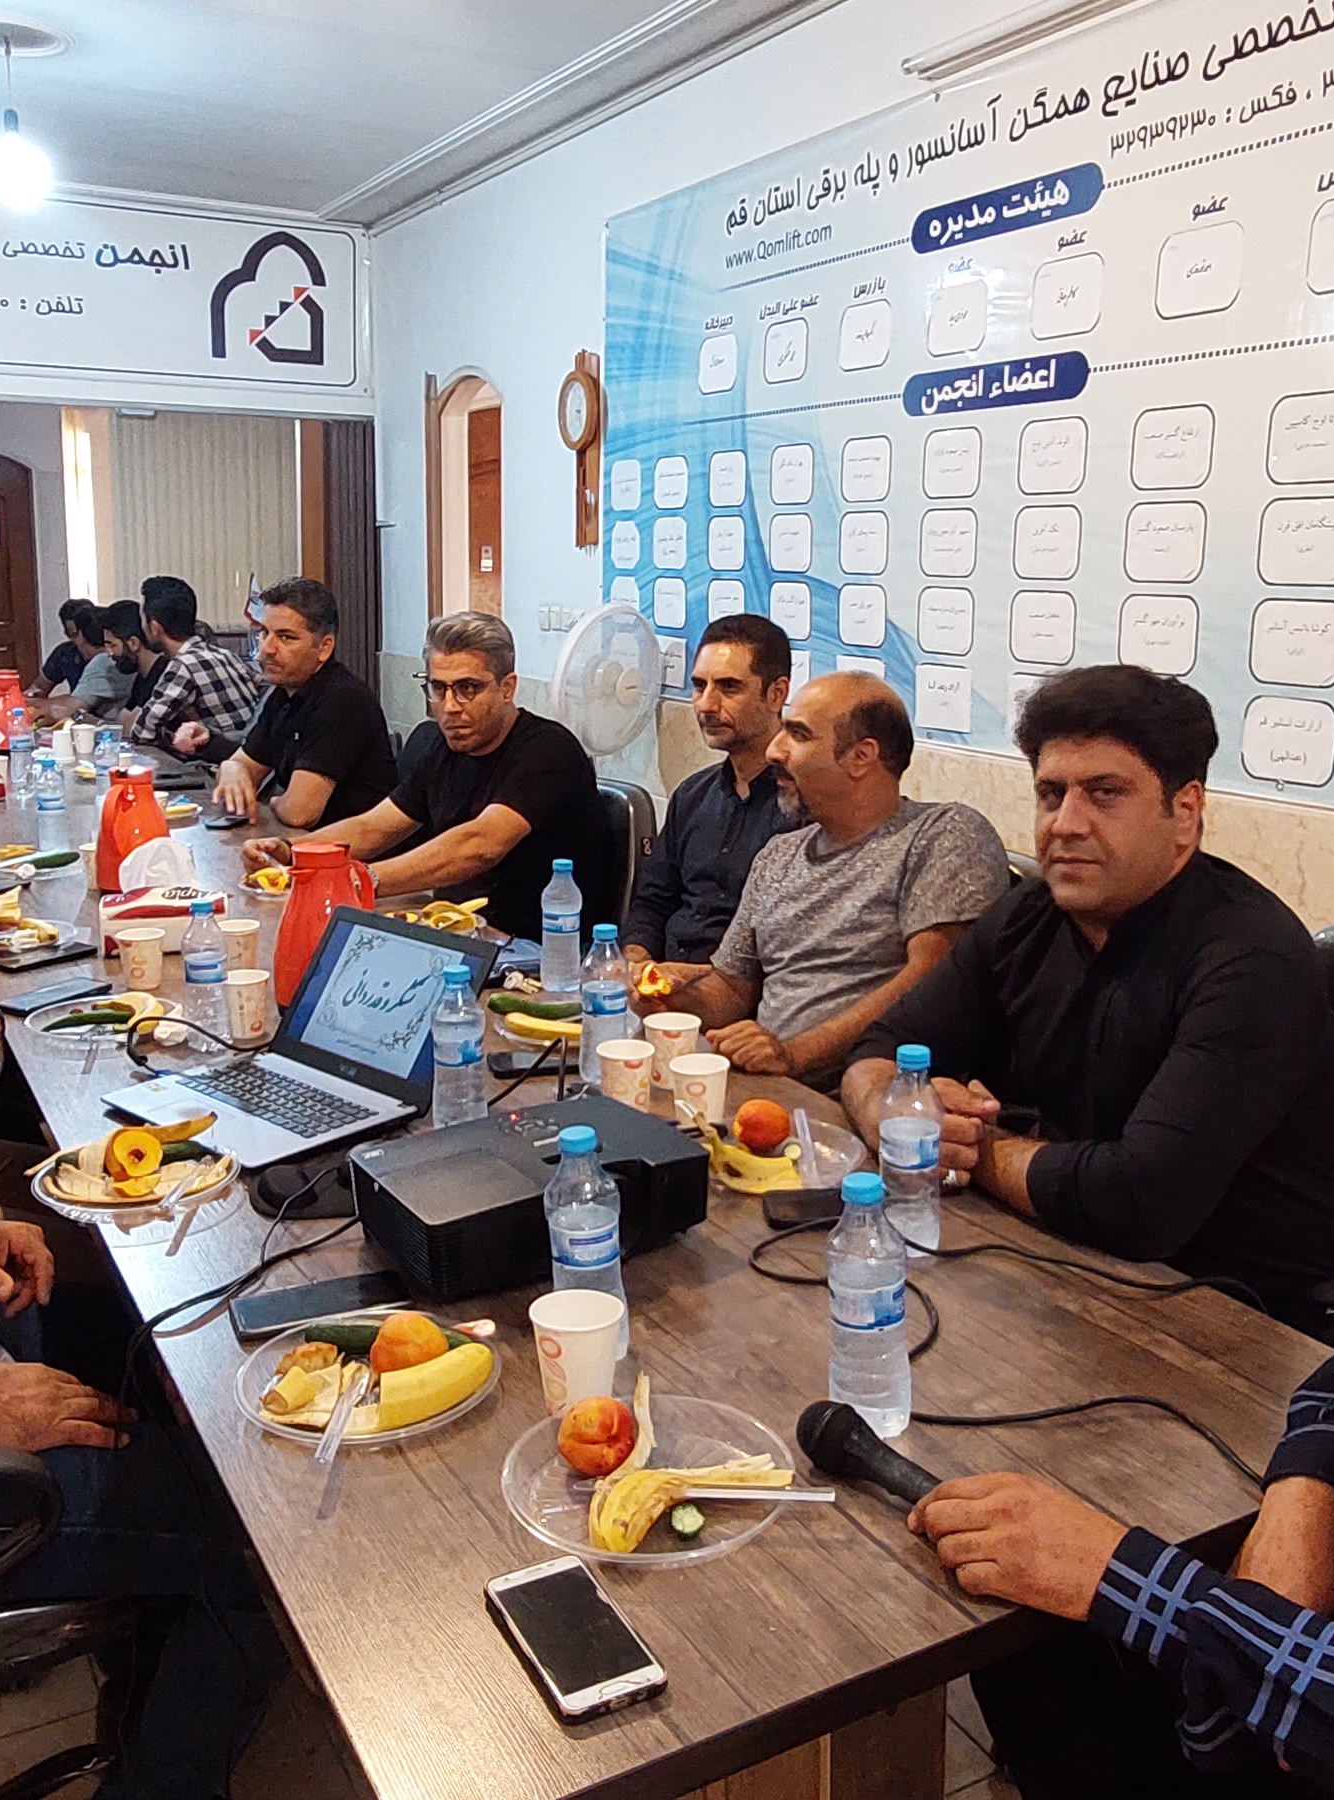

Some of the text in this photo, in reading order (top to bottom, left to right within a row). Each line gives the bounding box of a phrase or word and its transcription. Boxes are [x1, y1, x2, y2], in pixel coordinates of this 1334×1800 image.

[1100, 49, 1190, 118] صنایع
[1238, 81, 1298, 125] فکس
[1008, 87, 1091, 142] همگن
[1109, 107, 1217, 159] ۳۲۹۳۹۲۳۰
[906, 94, 1002, 179] آسانسور
[854, 153, 880, 196] پله
[888, 154, 899, 181] و
[753, 177, 801, 226] استان
[806, 168, 847, 211] برقی
[1191, 195, 1228, 221] عضو
[724, 203, 749, 235] قم
[928, 179, 1071, 246] هیئت مدیره
[2, 239, 85, 259] تخصصی
[95, 242, 190, 274] انجمن
[725, 223, 832, 270] www.Qomlift.com
[1057, 229, 1088, 252] عضو
[35, 295, 85, 316] تلفن
[759, 294, 820, 320] عضو علی البدل
[853, 276, 886, 299] بازرس
[920, 358, 1056, 415] اعضاء انجمن
